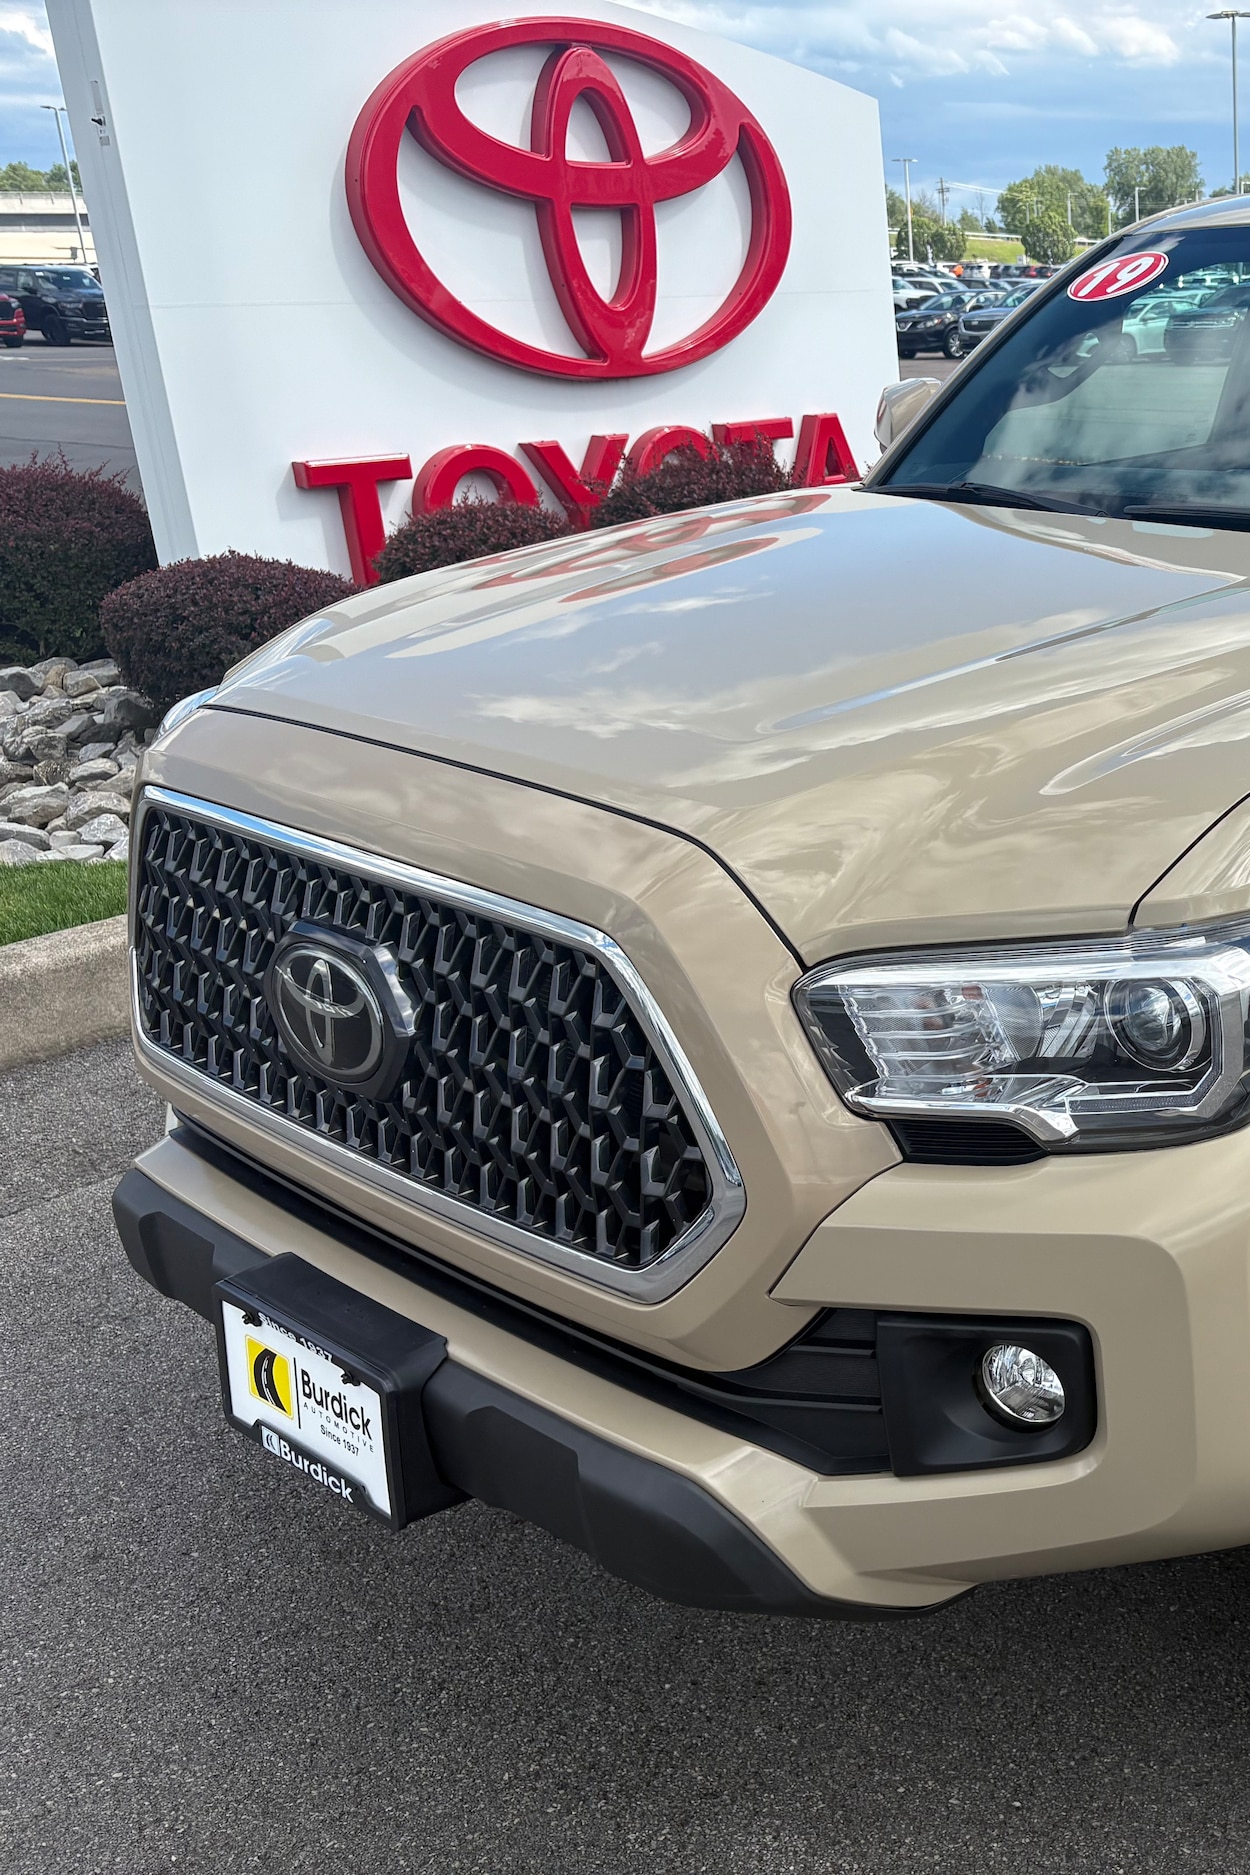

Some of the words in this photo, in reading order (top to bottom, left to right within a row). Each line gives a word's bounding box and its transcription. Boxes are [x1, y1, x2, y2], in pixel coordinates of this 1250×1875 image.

[1077, 256, 1154, 297] 19
[292, 412, 862, 586] TOYOTA
[258, 1312, 296, 1342] Since
[299, 1335, 333, 1363] 1937
[301, 1368, 373, 1442] Burdick
[303, 1402, 374, 1454] AUTOMOTIVE
[320, 1424, 342, 1446] Since
[342, 1438, 360, 1457] 1937
[280, 1439, 354, 1504] Burdick
